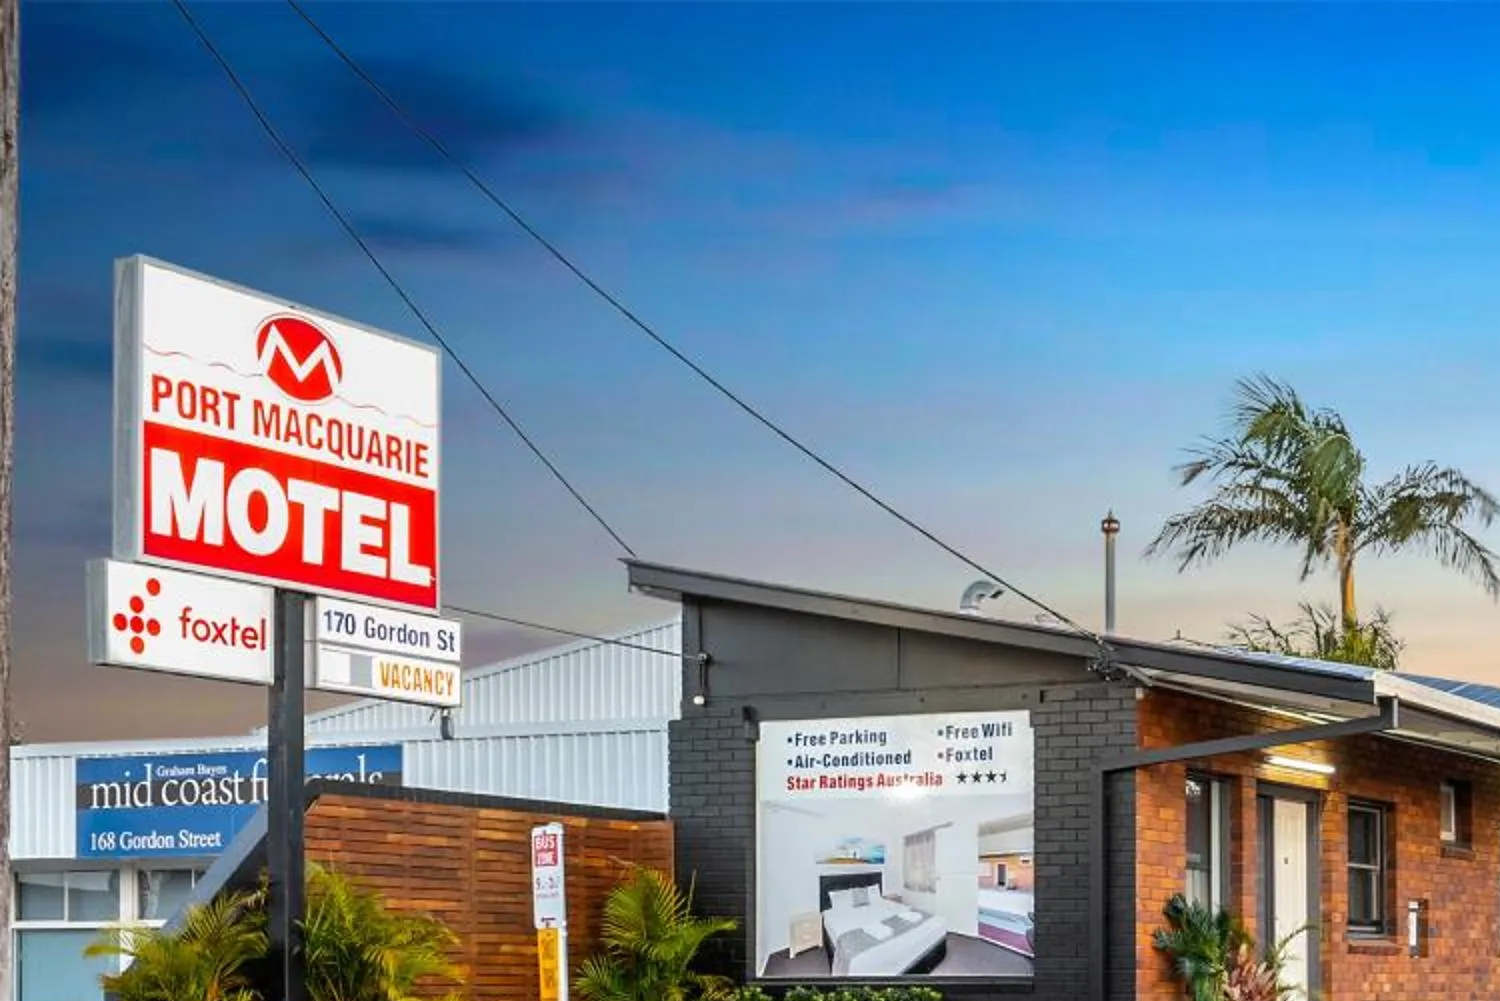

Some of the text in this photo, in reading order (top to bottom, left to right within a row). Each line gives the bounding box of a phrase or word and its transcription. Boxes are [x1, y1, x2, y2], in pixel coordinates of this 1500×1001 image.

[151, 373, 430, 479] PORT MACQUARIE
[150, 446, 433, 588] MOTEL
[178, 607, 267, 652] foxtel
[323, 609, 456, 653] 170 Gordon St
[379, 660, 455, 698] VACANCY
[794, 730, 887, 748] Free Parking
[945, 720, 1014, 740] Free Wifi
[794, 749, 912, 770] Air-Conditioned
[945, 745, 994, 763] Foxtel
[90, 763, 152, 809] mid
[161, 768, 245, 807] coast
[786, 774, 816, 792] Star
[819, 771, 873, 791] Ratings
[91, 828, 222, 851] 168 Gordon Street
